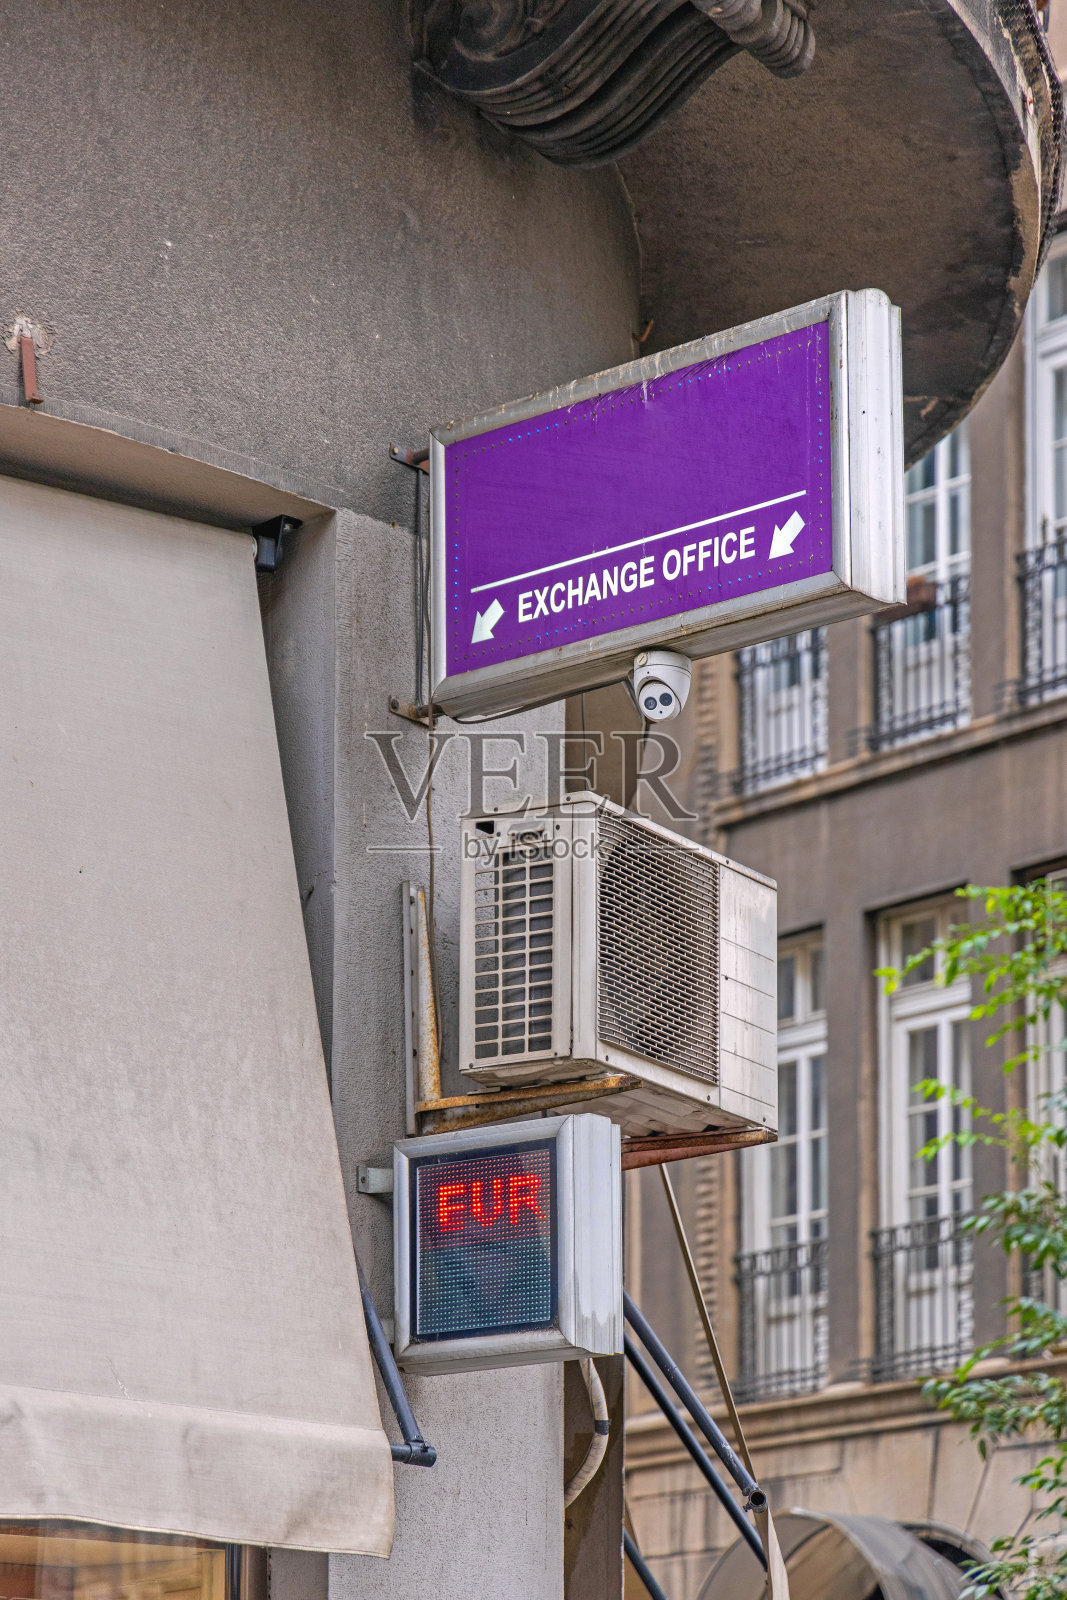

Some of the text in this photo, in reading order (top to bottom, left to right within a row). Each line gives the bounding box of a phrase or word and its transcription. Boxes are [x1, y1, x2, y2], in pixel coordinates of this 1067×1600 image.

[518, 526, 756, 624] EXCHANGE OFFICE
[438, 1174, 546, 1232] EUR
